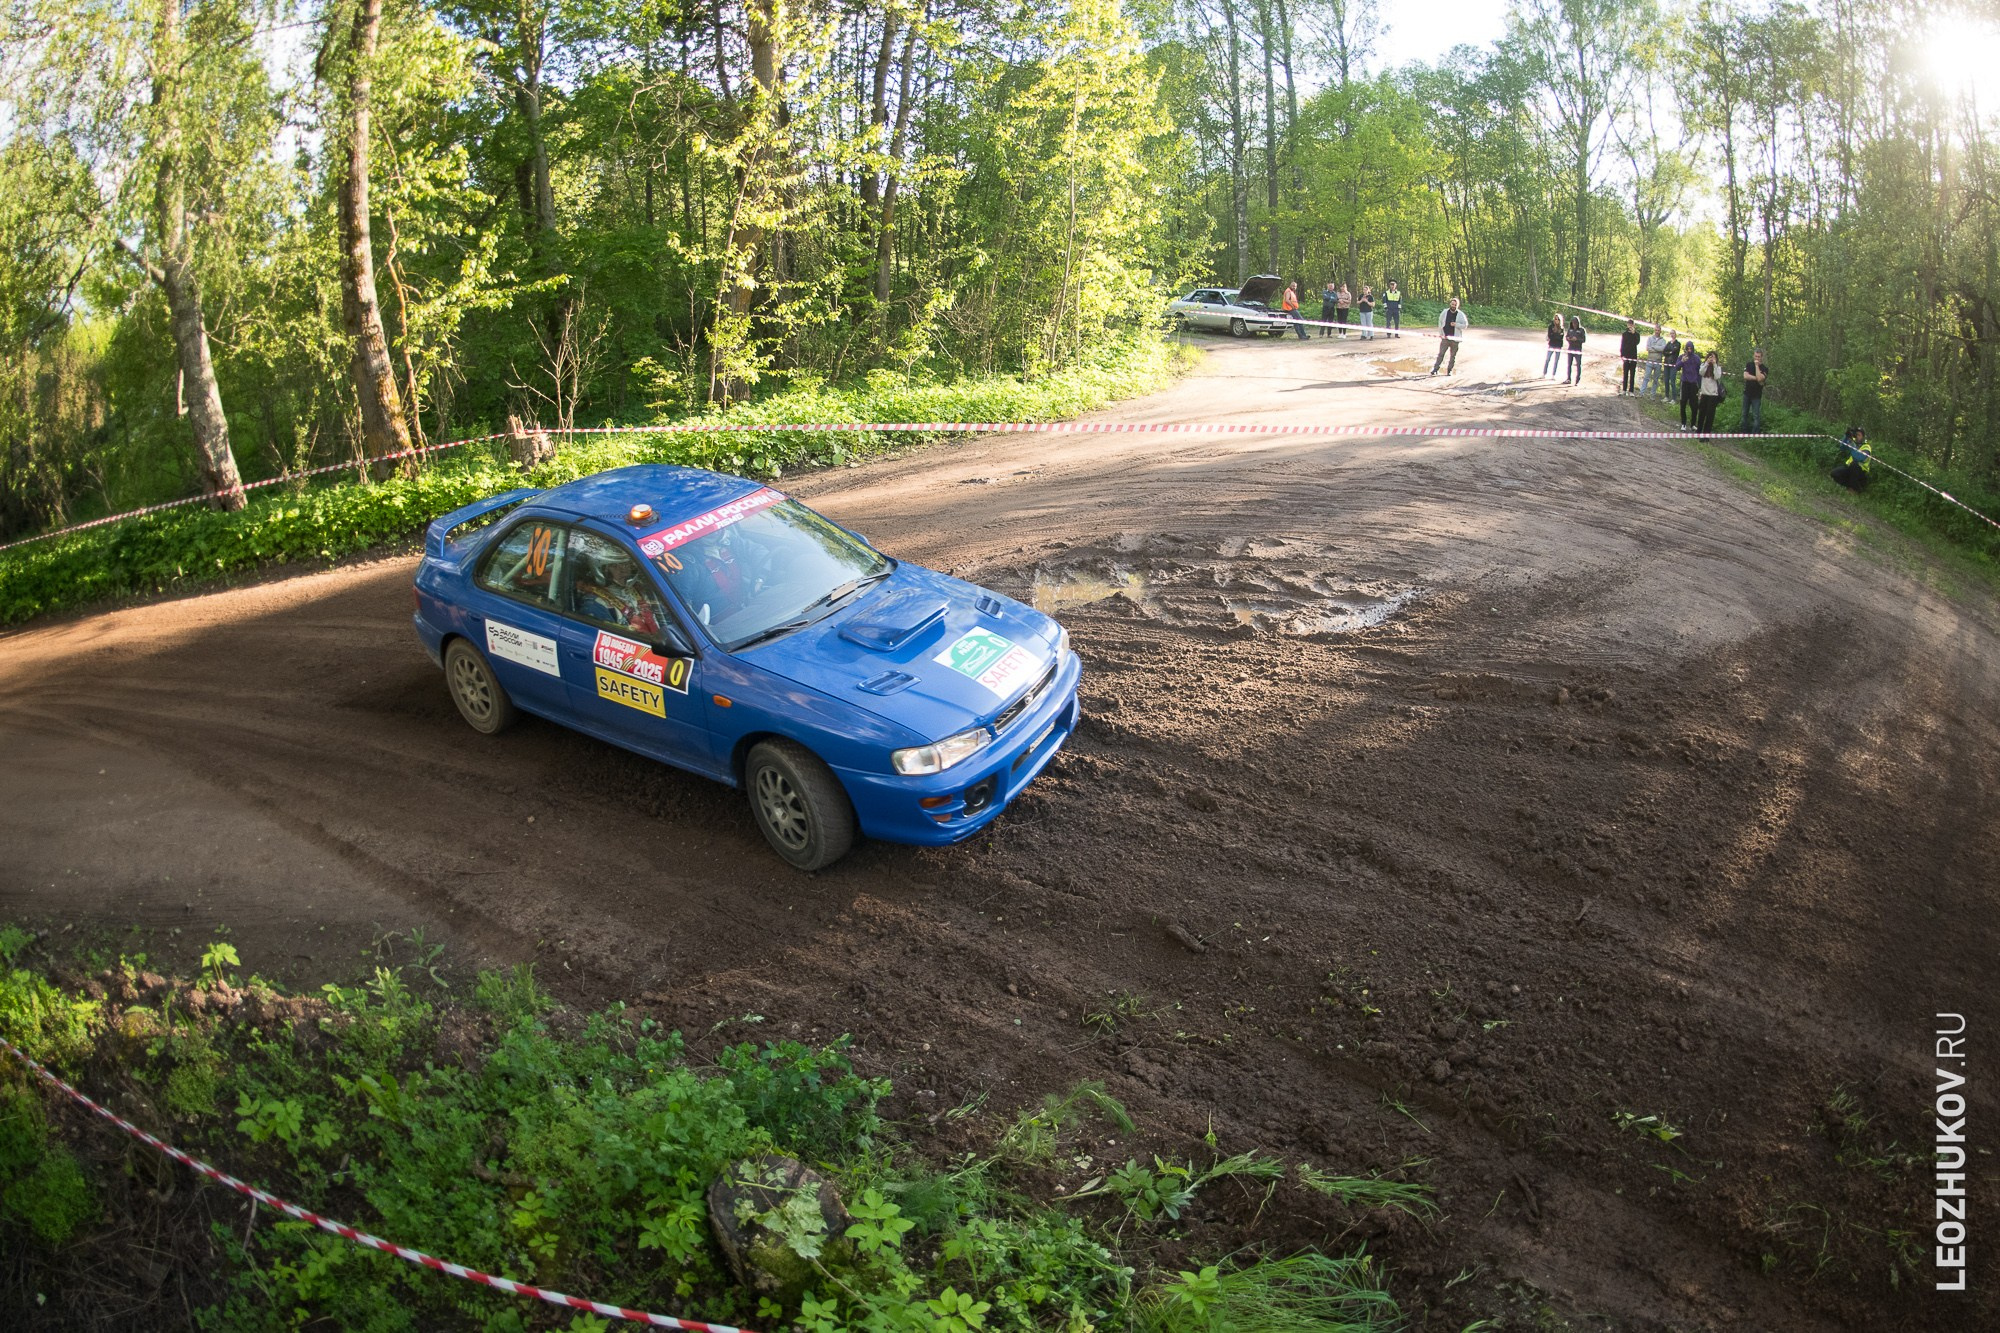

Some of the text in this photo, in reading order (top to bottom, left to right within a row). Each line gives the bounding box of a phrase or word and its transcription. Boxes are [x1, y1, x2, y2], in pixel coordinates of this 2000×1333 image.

[662, 494, 773, 546] РАЛЛИ РОССИИ
[598, 647, 663, 683] 1945 2025
[670, 659, 685, 686] 0
[982, 648, 1029, 689] SAFETY
[599, 676, 660, 708] SAFETY
